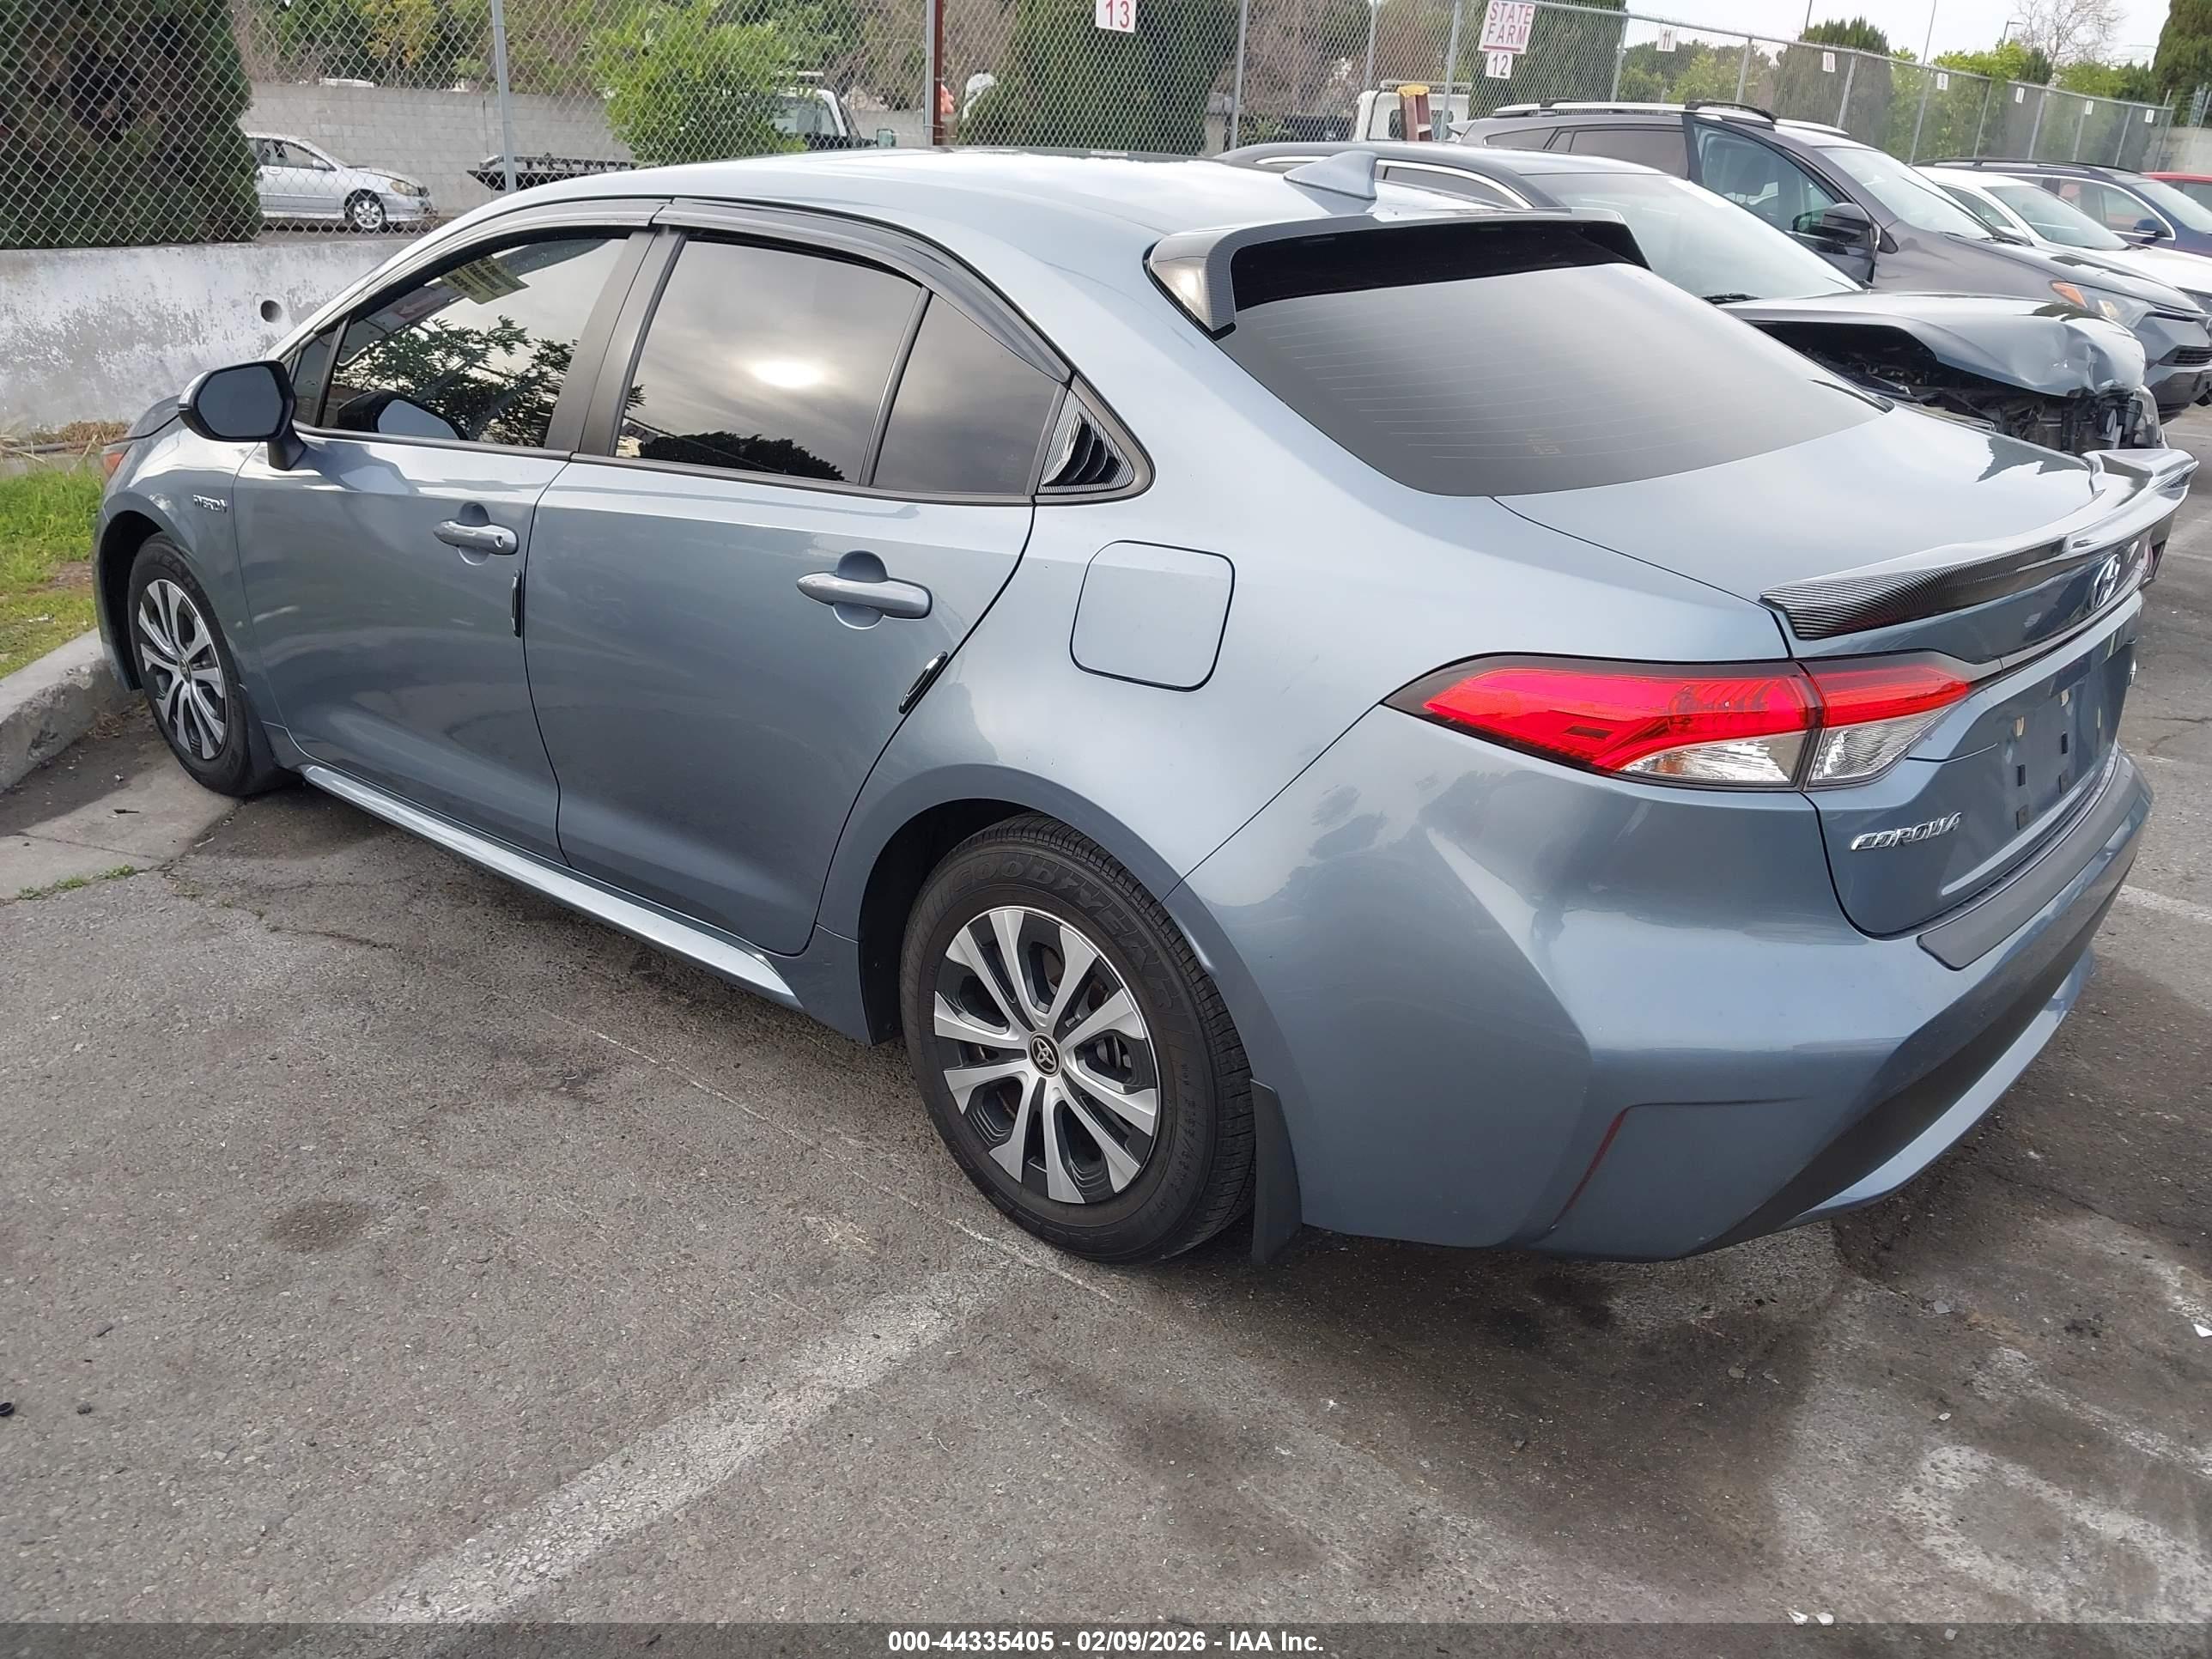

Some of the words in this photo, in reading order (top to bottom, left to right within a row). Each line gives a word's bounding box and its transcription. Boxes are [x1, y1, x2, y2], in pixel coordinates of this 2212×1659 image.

[1106, 0, 1130, 28] 13
[1490, 2, 1533, 24] STATE
[1486, 23, 1527, 45] FARM
[1662, 29, 1672, 50] 11
[1492, 54, 1508, 76] 12
[1850, 811, 1962, 852] COROLLA
[953, 859, 1185, 1015] GOODYEAR
